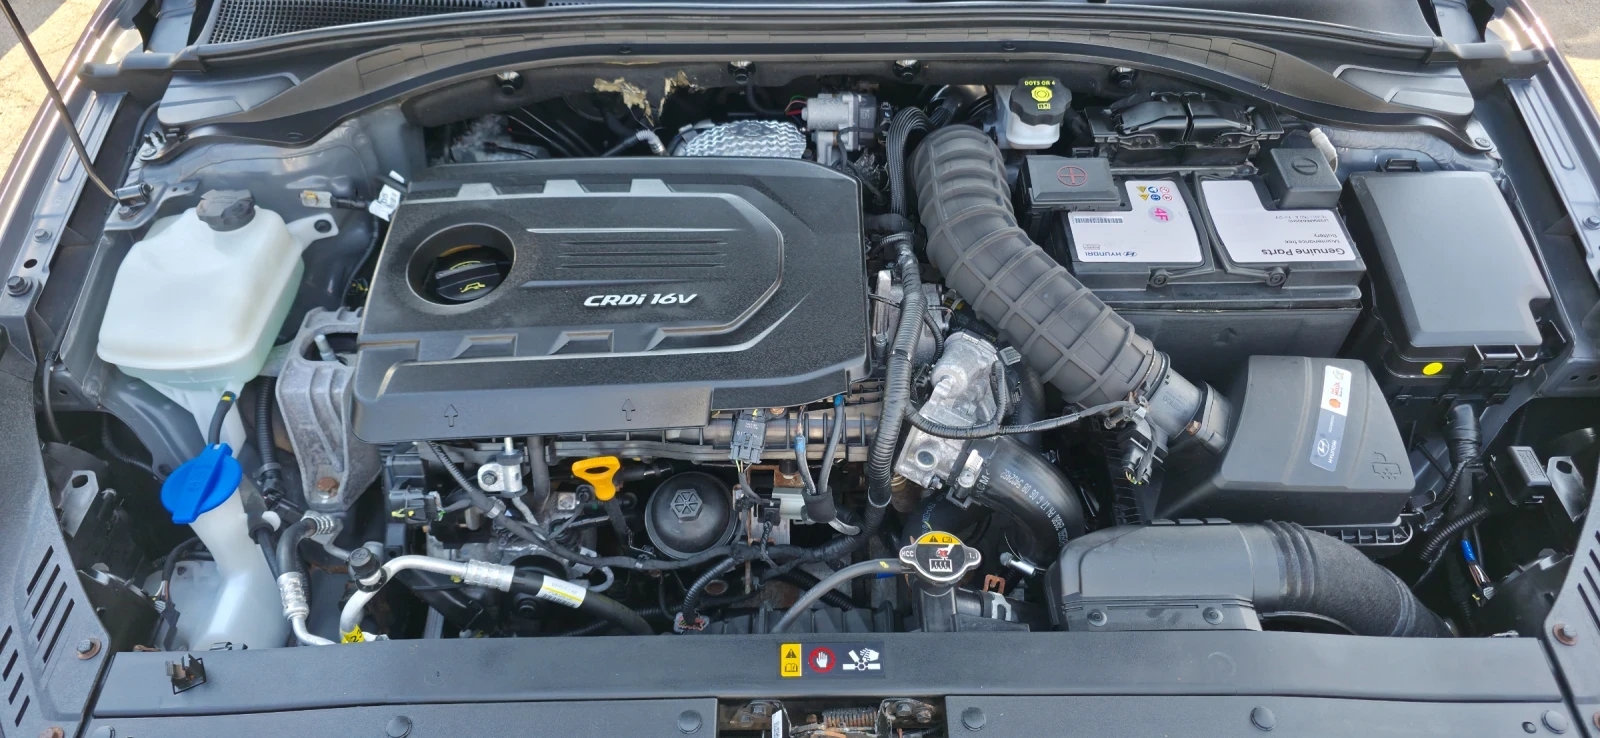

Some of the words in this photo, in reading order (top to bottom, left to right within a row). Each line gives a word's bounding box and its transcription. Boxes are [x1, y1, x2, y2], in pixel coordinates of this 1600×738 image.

[1154, 207, 1169, 222] 4F
[1261, 248, 1294, 256] Parts
[1295, 247, 1346, 256] Genuine
[583, 293, 648, 307] CRDi
[650, 293, 698, 305] 16V
[1328, 439, 1337, 464] HYUNDAI
[1039, 500, 1051, 511] 17
